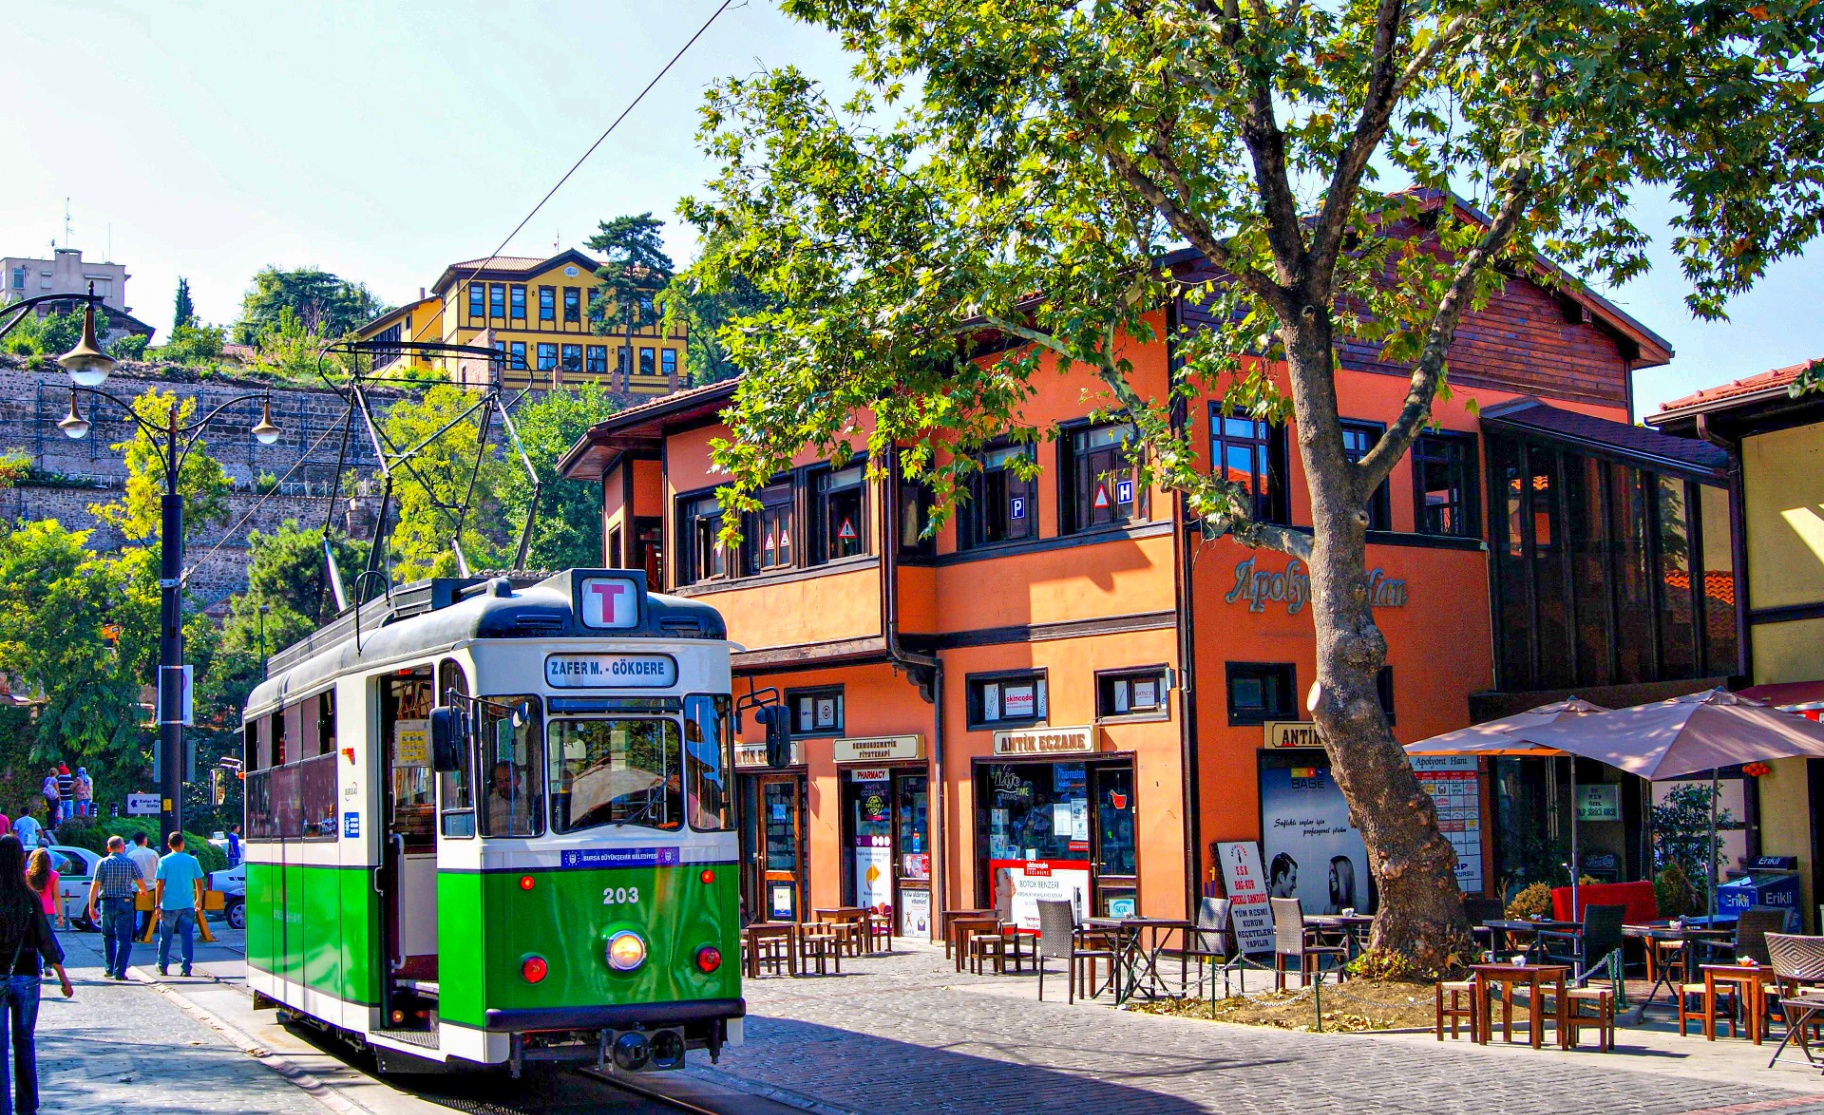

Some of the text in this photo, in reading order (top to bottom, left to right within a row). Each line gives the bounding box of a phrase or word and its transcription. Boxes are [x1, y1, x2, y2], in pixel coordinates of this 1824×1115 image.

[1120, 484, 1130, 501] H
[1014, 500, 1022, 517] P
[591, 583, 625, 624] T
[551, 661, 588, 675] ZAFER
[590, 661, 603, 675] M.
[612, 658, 665, 675] GÖKDERE
[1006, 693, 1033, 703] skincode
[1000, 733, 1086, 752] ANTİK ECZANE
[857, 770, 886, 780] PHARMACY
[603, 886, 639, 904] 203
[1765, 891, 1792, 905] Erikli
